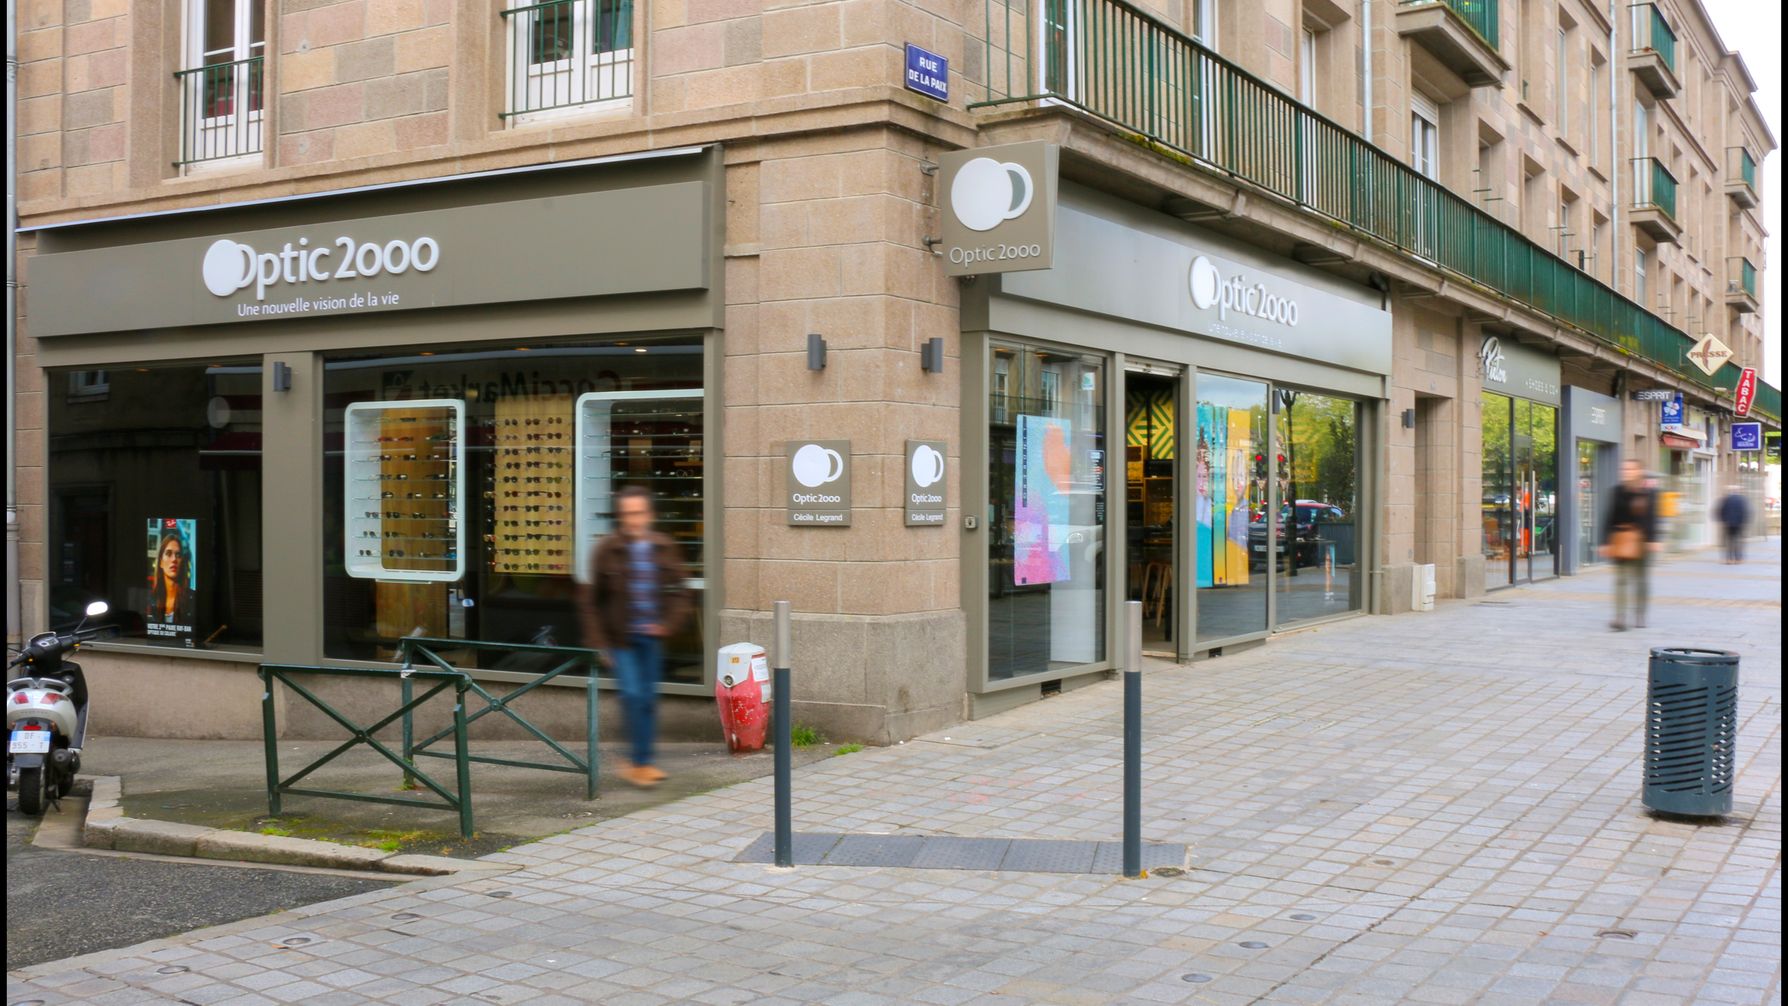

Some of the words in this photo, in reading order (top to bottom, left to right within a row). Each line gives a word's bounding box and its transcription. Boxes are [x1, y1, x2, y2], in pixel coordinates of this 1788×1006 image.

[919, 56, 938, 73] RUE
[908, 68, 920, 82] DE
[920, 73, 930, 87] LA
[930, 77, 947, 93] PAIX
[949, 245, 996, 268] Optic
[998, 243, 1041, 260] 2000
[203, 237, 331, 301] Optic
[334, 236, 440, 279] 2000
[237, 303, 260, 317] Une
[262, 297, 310, 315] nouvelle
[313, 294, 347, 311] vision
[349, 293, 365, 308] de
[367, 292, 378, 306] la
[381, 291, 399, 305] vie
[1256, 283, 1298, 327] 2000
[1690, 350, 1728, 359] PRSSE
[1637, 391, 1671, 400] ESPRIT
[1737, 370, 1753, 413] TABAC
[792, 493, 818, 505] Optic
[818, 493, 841, 503] 2000
[911, 493, 928, 505] Optic
[928, 493, 942, 503] 2000
[816, 513, 843, 523] Legrand
